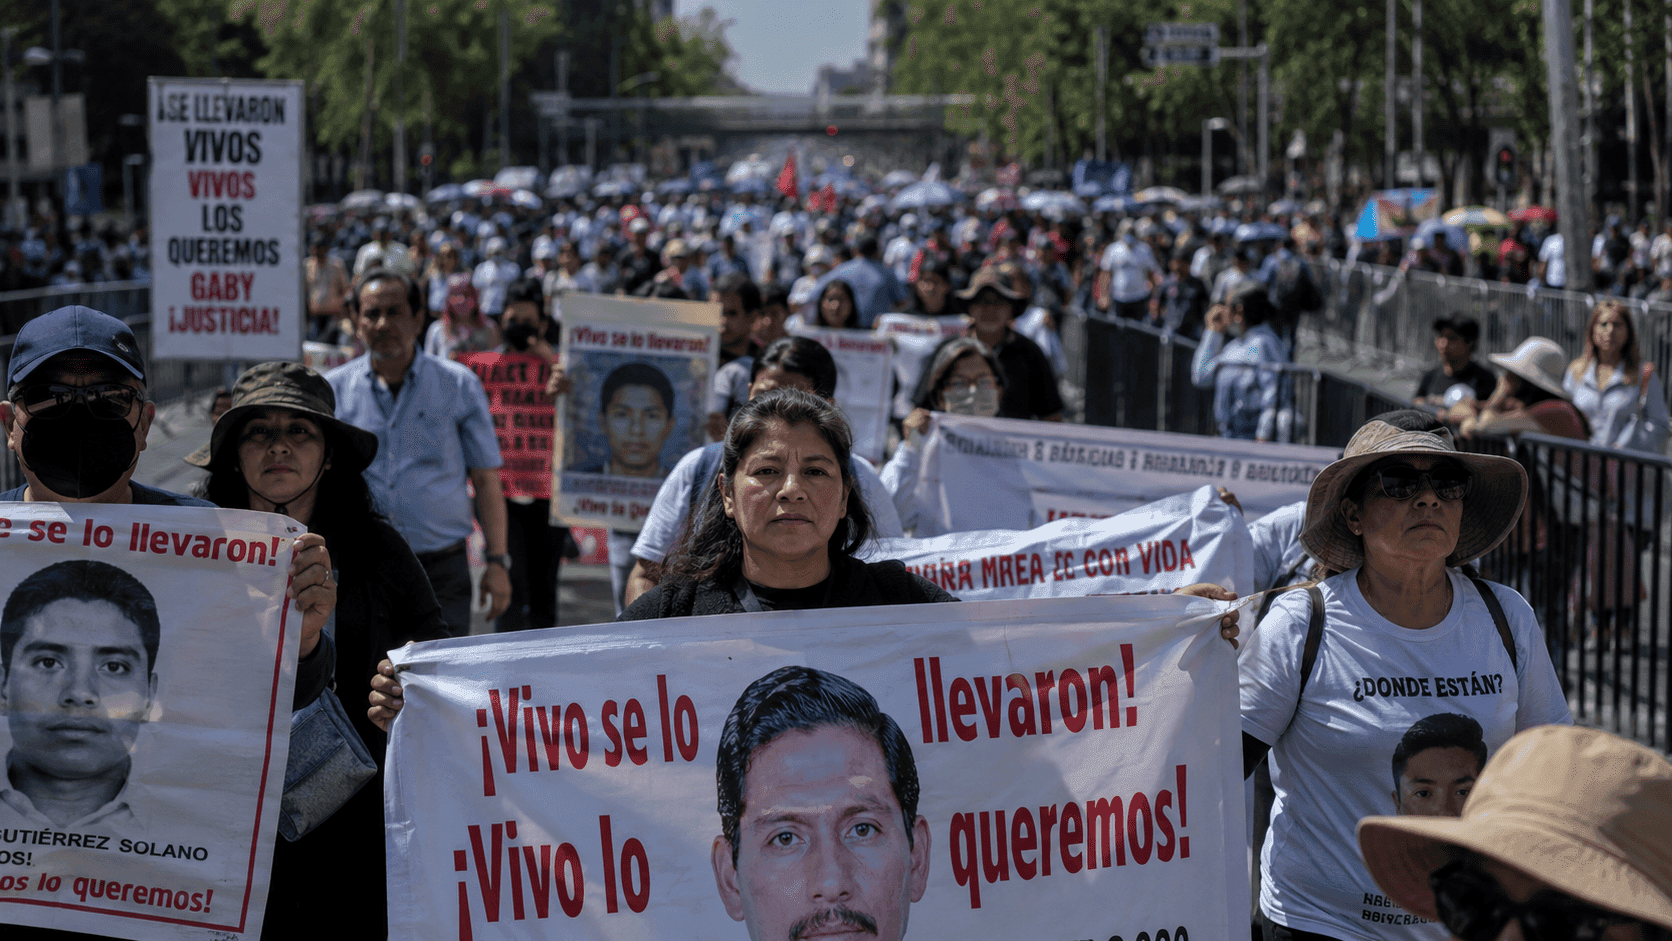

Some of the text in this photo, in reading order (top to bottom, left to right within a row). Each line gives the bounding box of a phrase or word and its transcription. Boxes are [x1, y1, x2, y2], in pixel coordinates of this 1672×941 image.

[194, 94, 286, 125] LLEVARON
[184, 129, 262, 164] VIVOS
[188, 169, 256, 199] VIVOS
[202, 204, 243, 232] LOS
[167, 236, 280, 265] QUEREMOS
[191, 271, 254, 301] GABY
[168, 306, 280, 334] ¡JUSTICIA!
[27, 519, 67, 544] se
[82, 518, 114, 548] lo
[129, 522, 281, 567] llevaron!
[1136, 539, 1196, 574] VIDA
[1353, 670, 1503, 702] ¿DONDE ESTÁN?
[476, 643, 1138, 797] ¡Vivo se lo llevaron!
[0, 828, 209, 862] UTIÉRREZ SOLANO
[453, 764, 1191, 941] ¡Vivo lo queremos!
[37, 872, 62, 893] lo
[72, 876, 214, 914] queremos!
